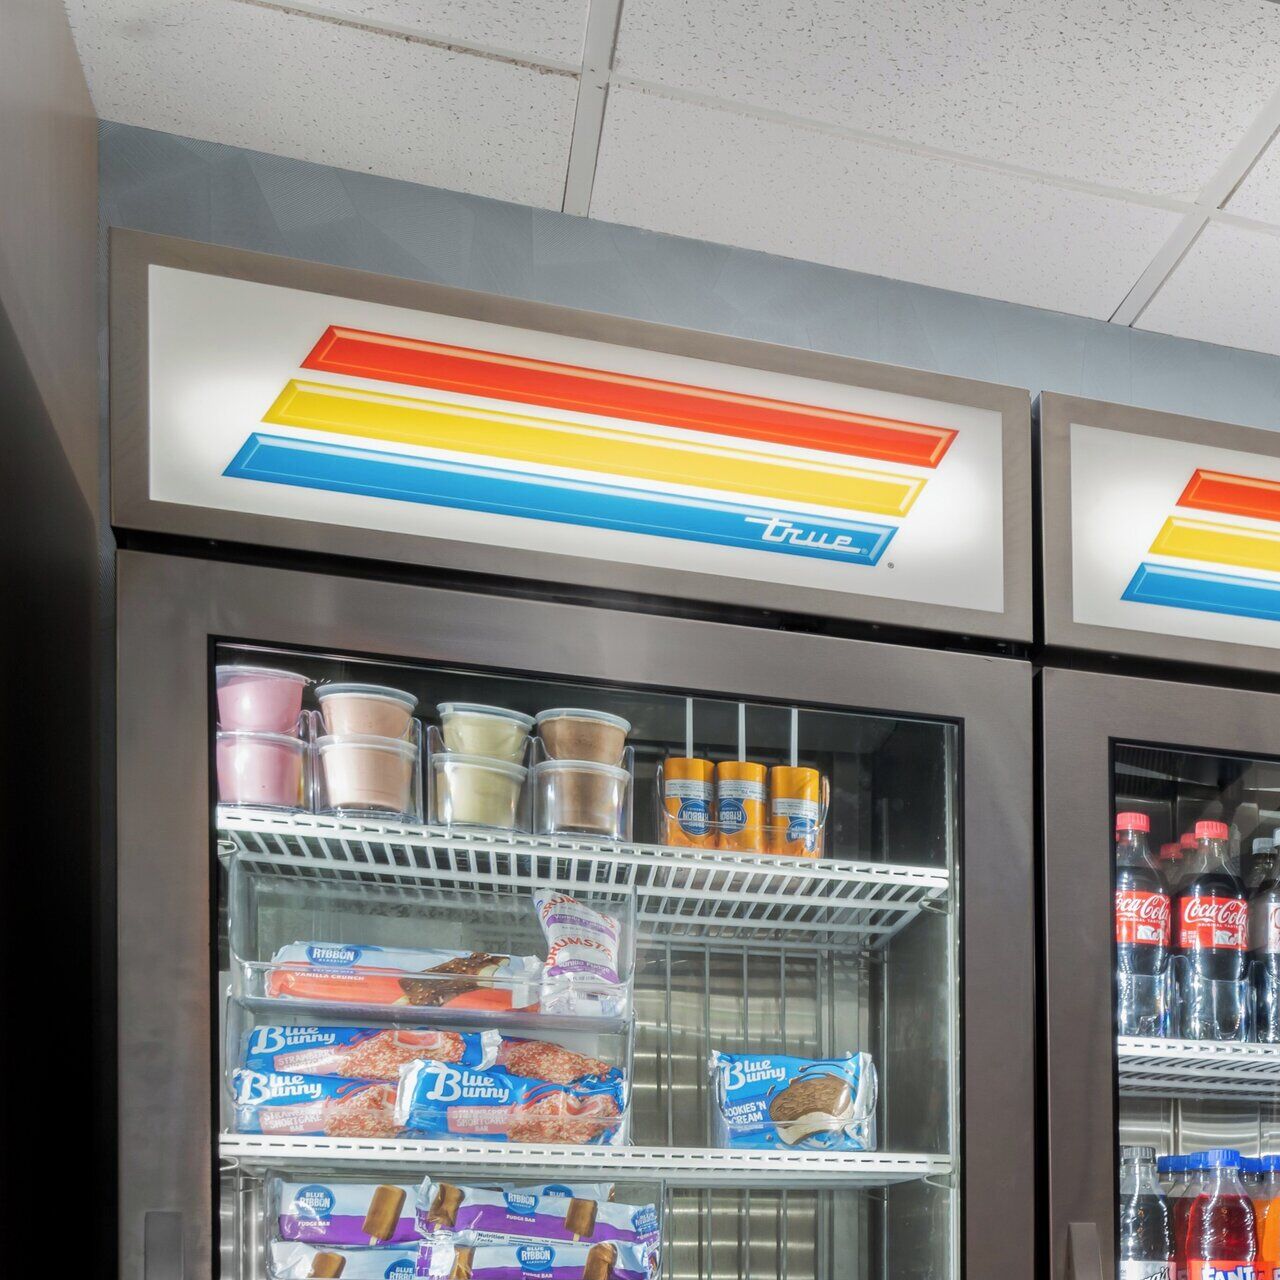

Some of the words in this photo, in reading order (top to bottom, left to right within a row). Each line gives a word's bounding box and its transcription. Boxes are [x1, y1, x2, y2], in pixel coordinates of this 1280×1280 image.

[744, 517, 861, 554] true
[1184, 899, 1248, 926] Coca-Cola
[312, 948, 355, 961] RIBBON
[295, 971, 329, 980] VANILLA
[331, 973, 365, 981] CRUNCH
[300, 1197, 331, 1208] RIBBON
[508, 1193, 535, 1205] RIBBON
[521, 1250, 551, 1261] RIBBON
